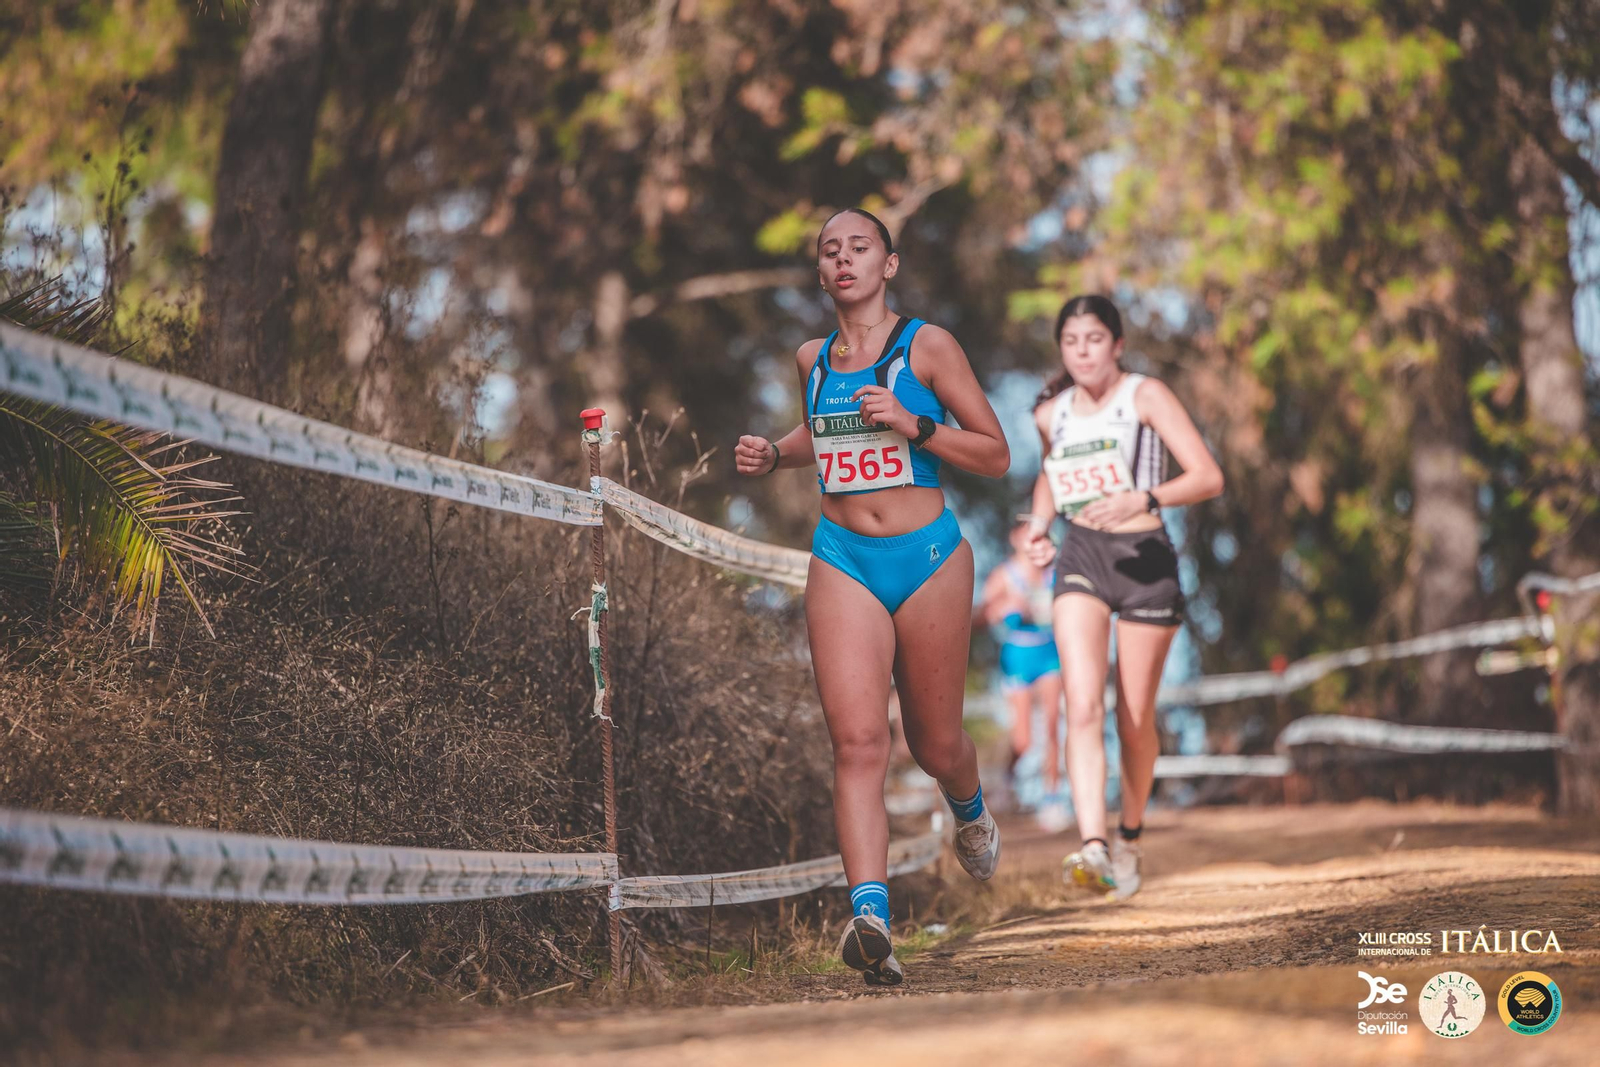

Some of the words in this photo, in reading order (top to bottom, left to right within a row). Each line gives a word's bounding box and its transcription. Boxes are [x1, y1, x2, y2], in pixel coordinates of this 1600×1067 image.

[830, 415, 870, 429] ITÁLIC
[818, 445, 903, 484] 7565
[1057, 463, 1122, 495] 5551
